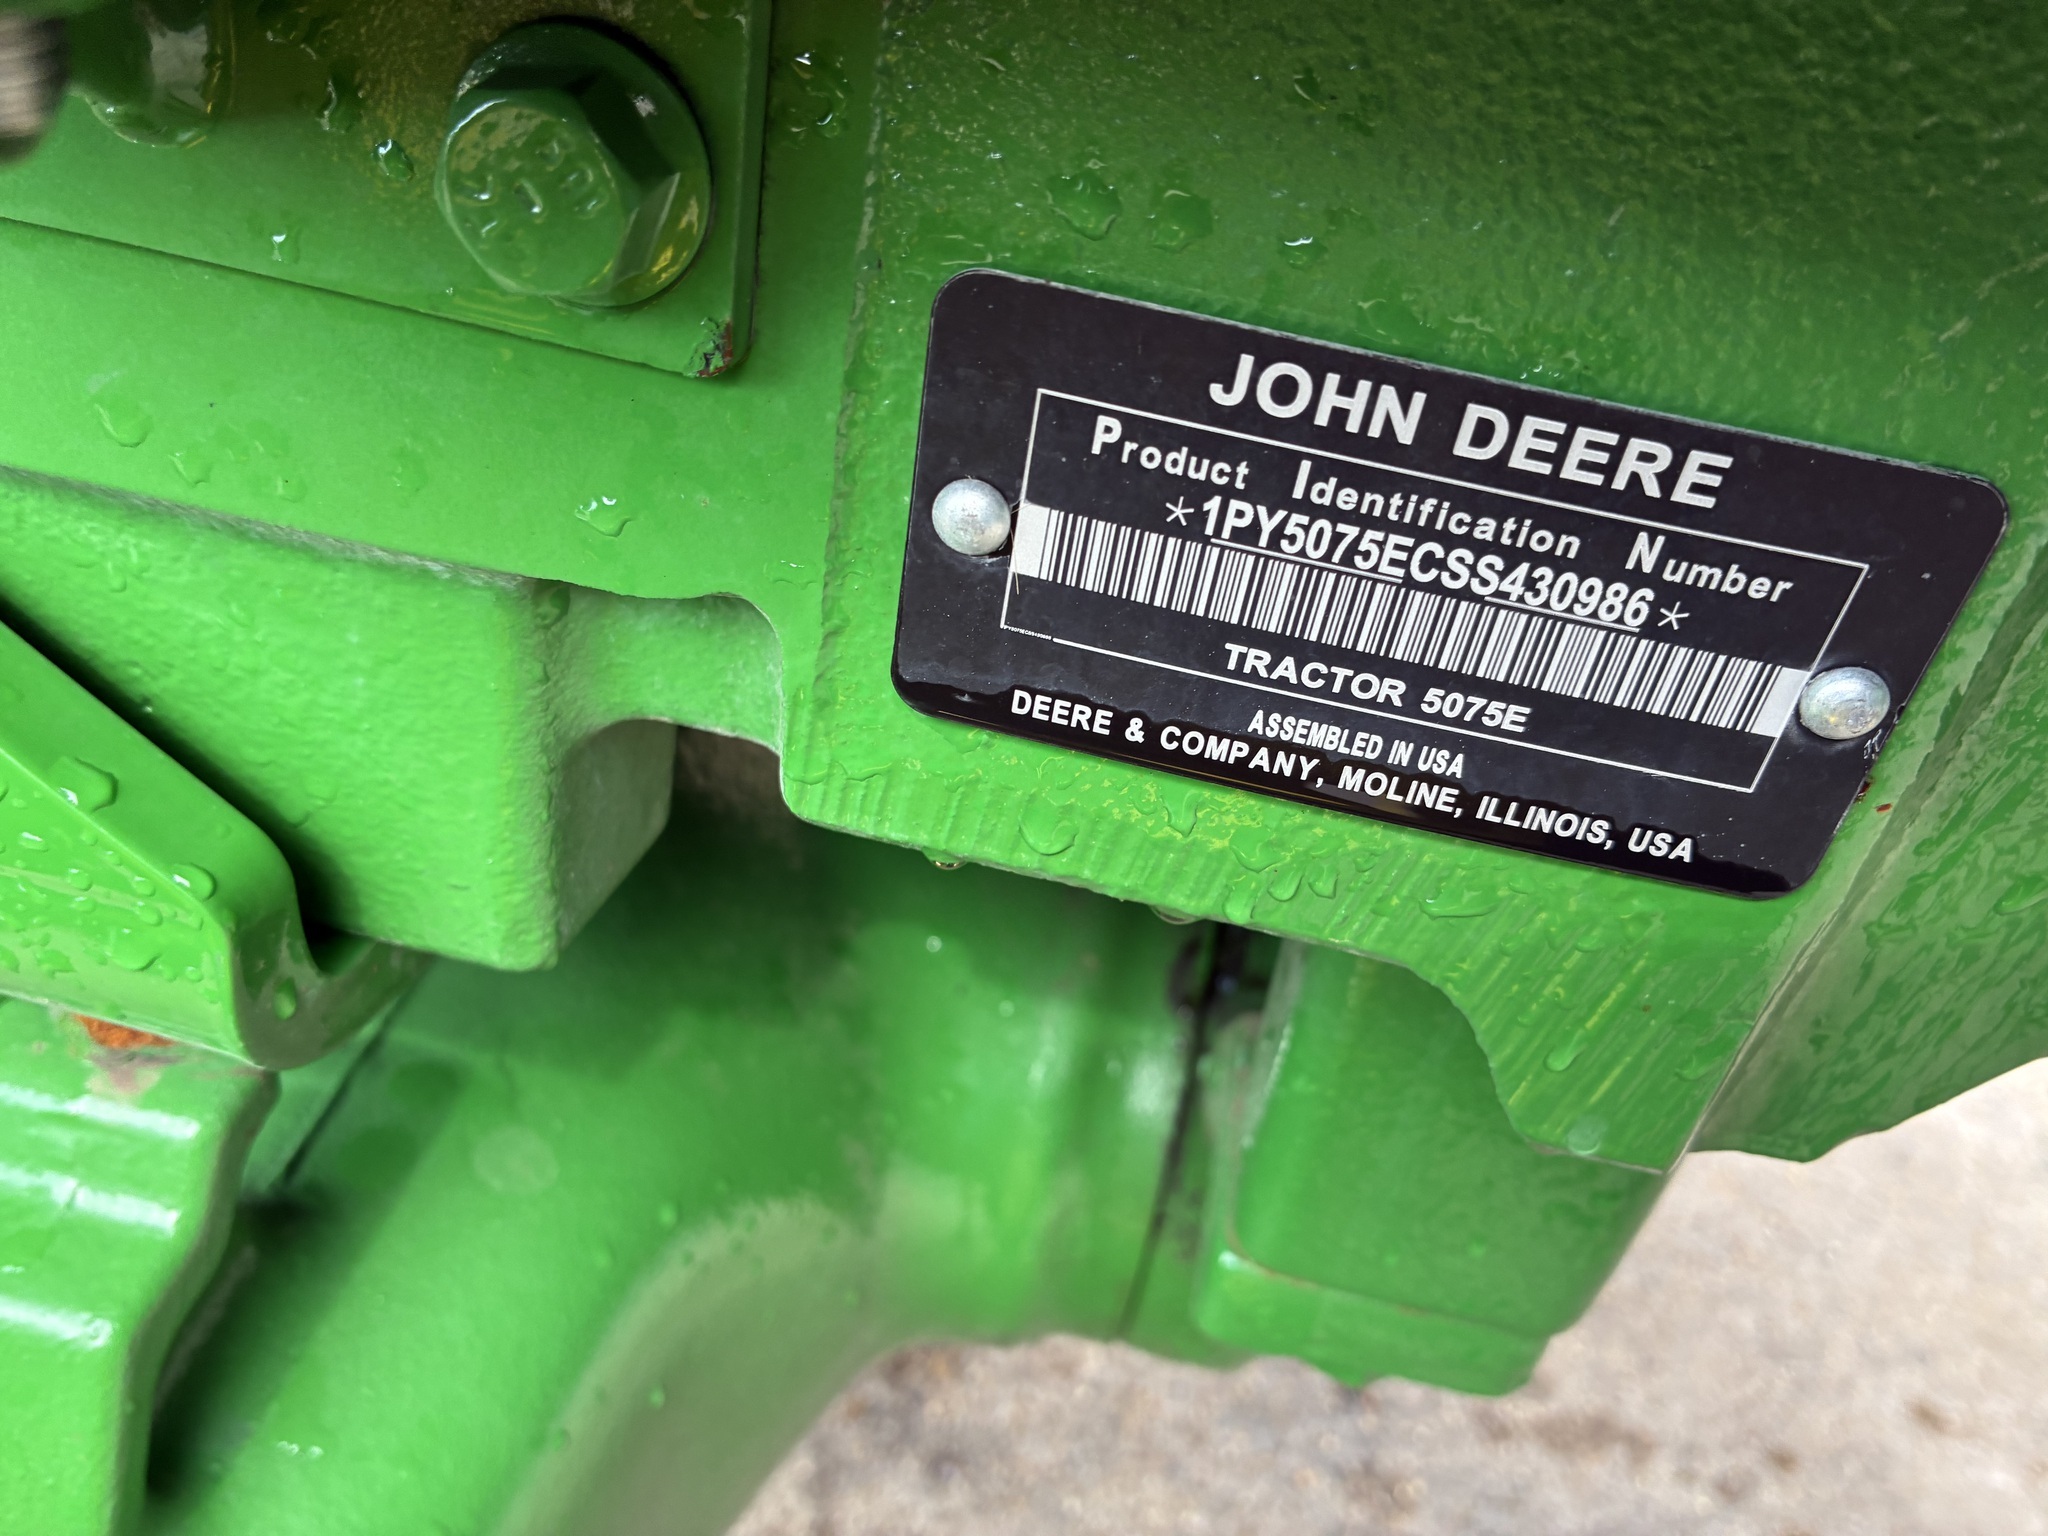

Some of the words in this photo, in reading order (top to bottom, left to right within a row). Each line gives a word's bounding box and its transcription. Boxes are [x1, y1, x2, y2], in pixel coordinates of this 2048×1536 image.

[1090, 414, 1250, 490] Product
[1291, 459, 1581, 560] Identification
[1624, 531, 1794, 603] Number
[1209, 353, 1427, 446] JOHN
[1452, 402, 1734, 509] DEERE
[1224, 642, 1407, 708] TRACTOR
[1420, 687, 1532, 733] 5075E
[1247, 709, 1384, 760] ASSEMBLED
[1386, 739, 1415, 767] IN
[1417, 745, 1465, 779] USA
[1011, 689, 1114, 736] DEERE
[1124, 717, 1145, 744] &
[1160, 725, 1324, 789] COMPANY,
[1337, 765, 1463, 819] MOLINE,
[1475, 795, 1613, 851] ILLINOIS,
[1627, 827, 1692, 863] USA
